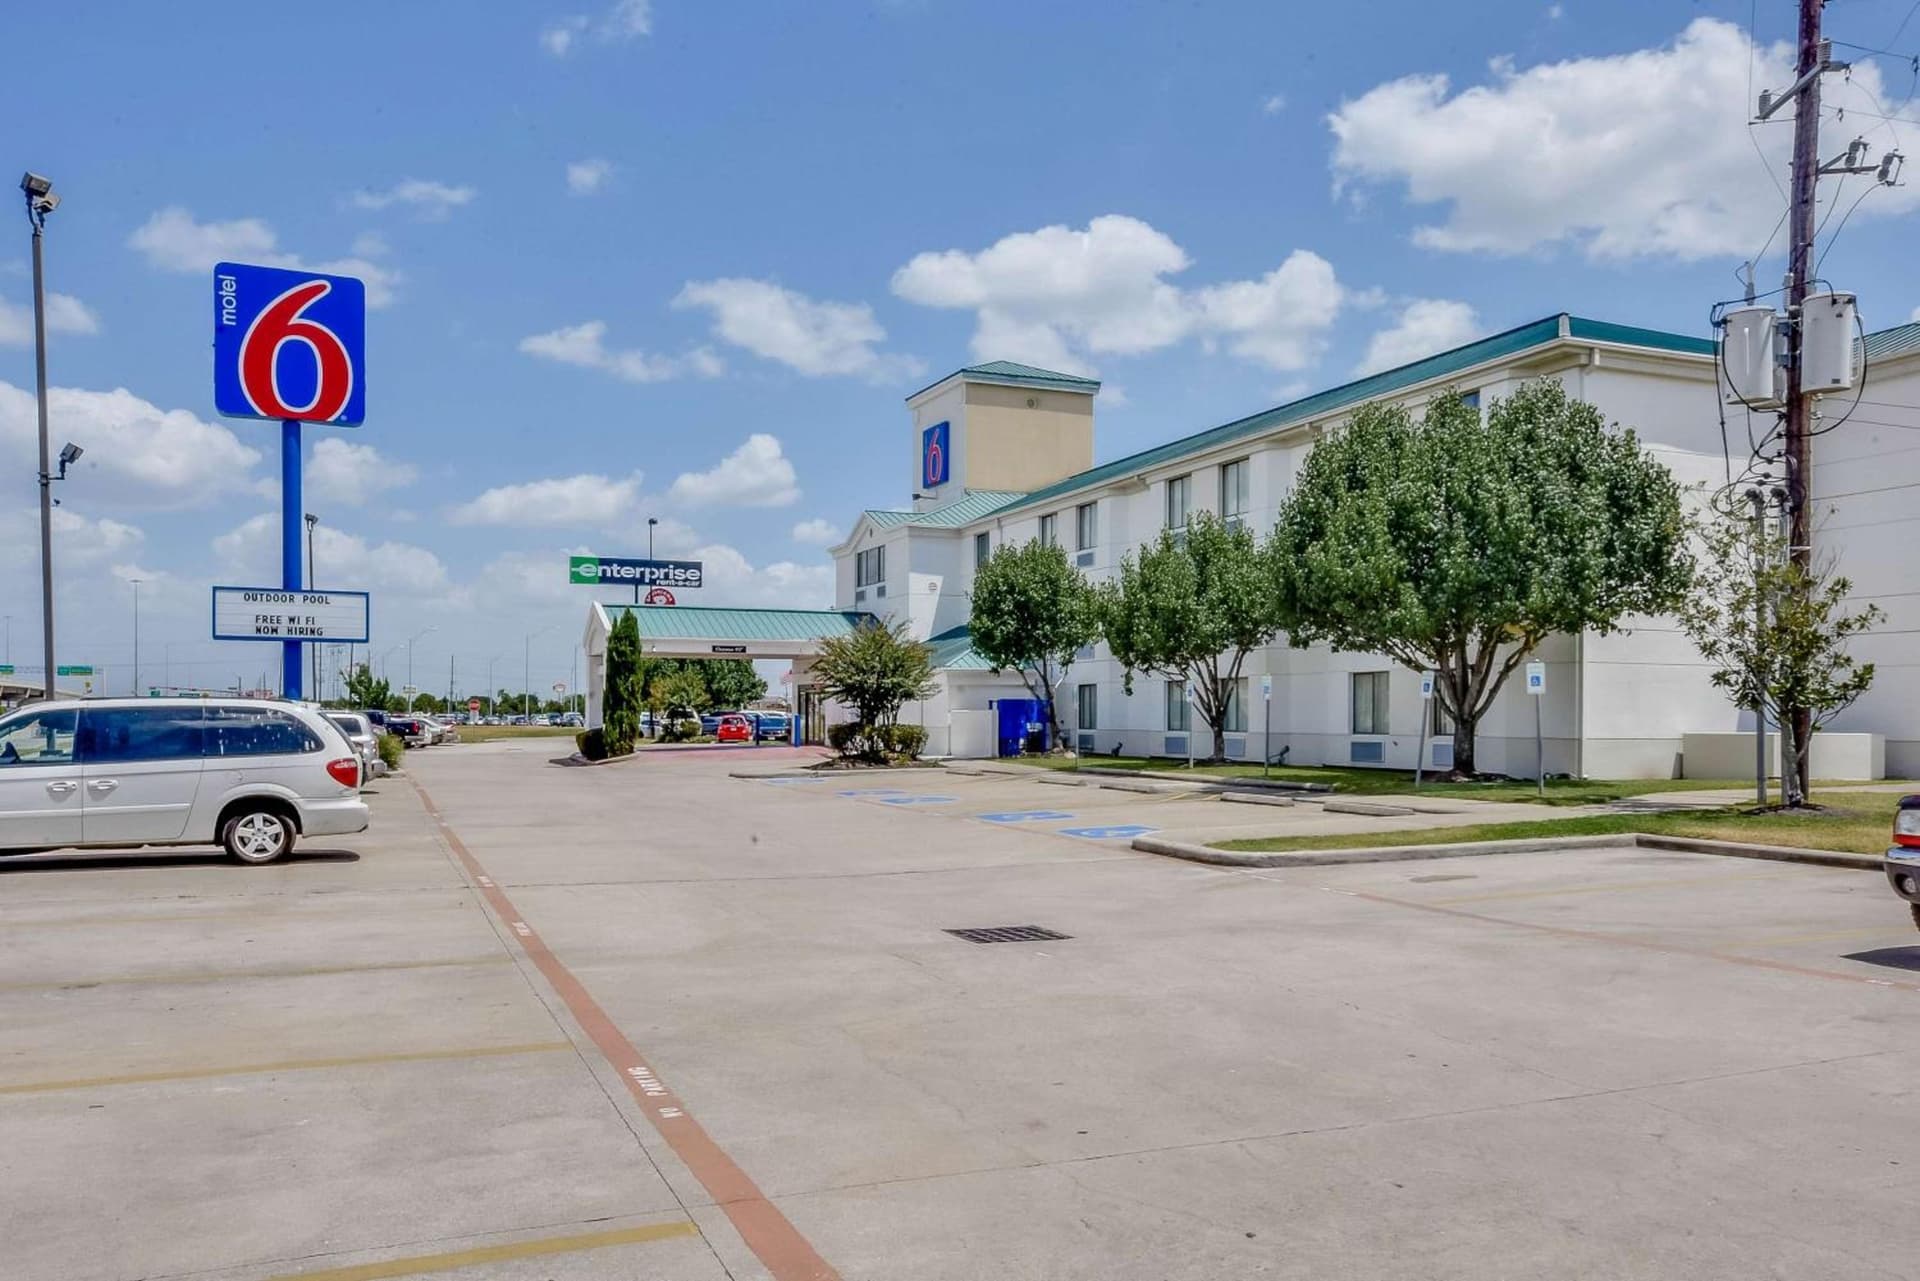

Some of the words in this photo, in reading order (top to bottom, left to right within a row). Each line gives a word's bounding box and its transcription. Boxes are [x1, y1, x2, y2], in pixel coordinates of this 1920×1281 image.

[217, 275, 237, 326] motel
[238, 279, 354, 422] 6
[927, 427, 943, 486] 6
[571, 563, 701, 583] enterprise
[243, 592, 296, 604] OUTDOOR
[302, 594, 331, 605] POOL
[255, 614, 283, 625] FREE
[287, 615, 301, 626] WI
[305, 616, 316, 626] FI
[255, 625, 279, 636] NOW
[287, 626, 324, 637] HIRING
